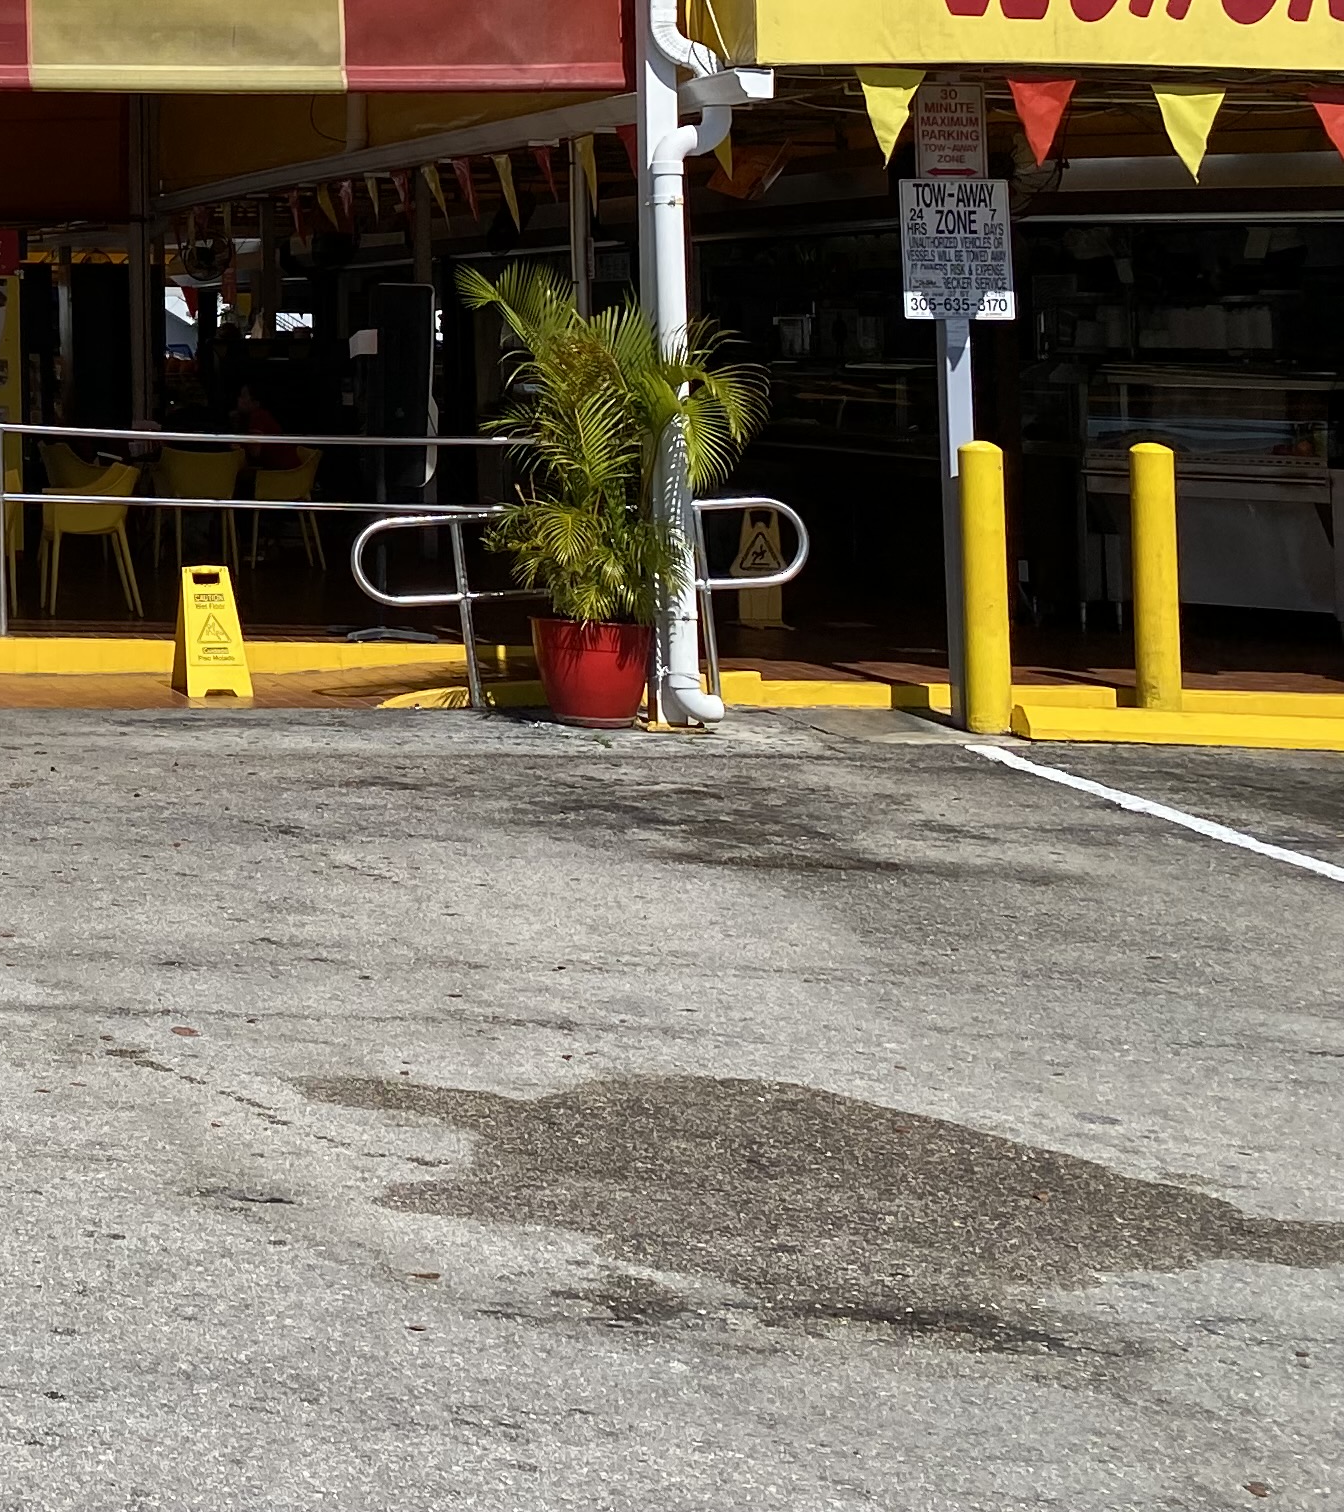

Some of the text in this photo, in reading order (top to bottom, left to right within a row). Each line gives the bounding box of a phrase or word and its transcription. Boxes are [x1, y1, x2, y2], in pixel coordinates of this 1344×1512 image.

[940, 89, 958, 100] 30
[924, 102, 975, 113] MINUTE
[921, 116, 979, 127] MAXIMUM
[922, 130, 980, 141] PARKING
[924, 144, 978, 153] TOW-AWAY
[937, 155, 966, 163] ZONE
[913, 183, 994, 208] TOW-AWAY
[909, 208, 924, 221] 24
[988, 208, 997, 222] 7
[935, 209, 977, 235] ZONE
[907, 222, 928, 236] HRS
[983, 223, 1004, 236] DAYS
[908, 236, 1003, 249] UNAUTHORIZED VEHICLES OR
[907, 250, 936, 262] VESSELS
[937, 250, 953, 262] WILL
[954, 250, 964, 262] BE
[966, 250, 989, 262] TOWED
[950, 264, 966, 276] RISK
[975, 264, 1005, 276] EXPENSE
[942, 277, 972, 289] RECKER
[974, 277, 1008, 290] SERVICE
[910, 297, 1008, 312] 305-635-3170
